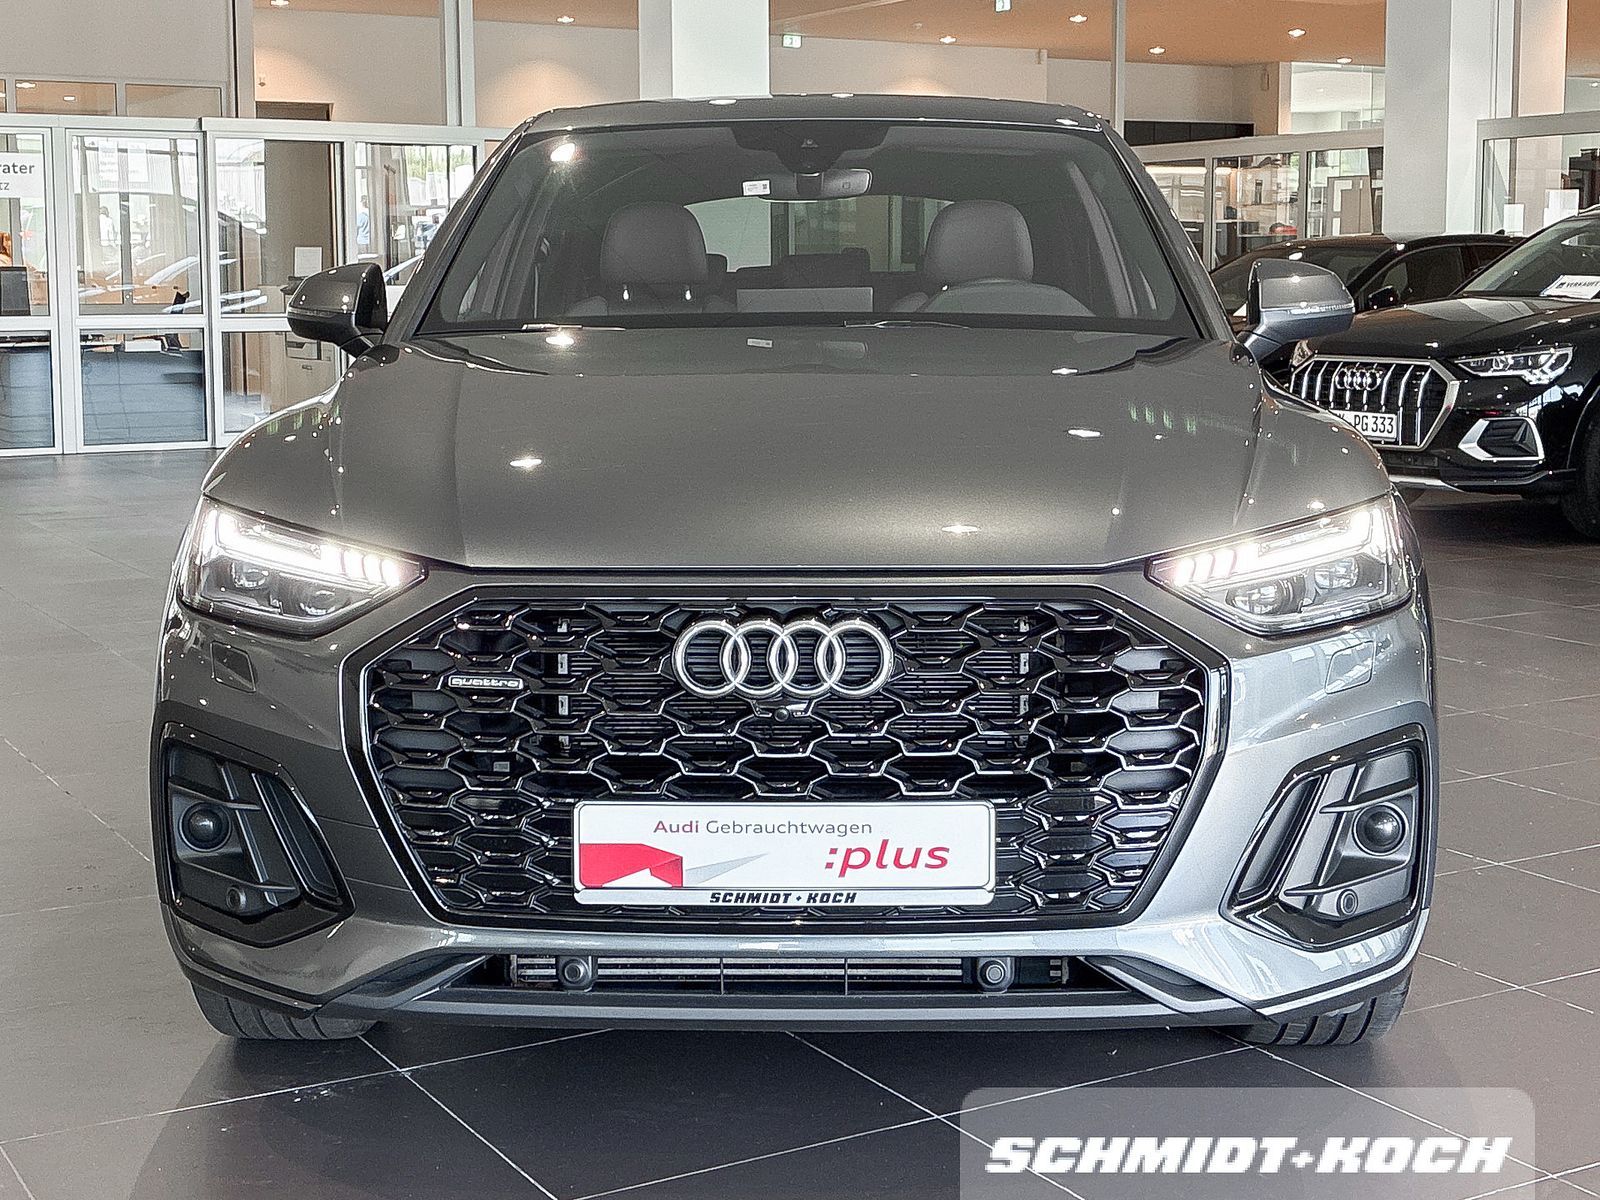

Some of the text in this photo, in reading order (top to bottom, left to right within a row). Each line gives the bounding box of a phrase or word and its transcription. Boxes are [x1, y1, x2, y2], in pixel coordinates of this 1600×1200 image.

[1354, 415, 1369, 431] PG
[1371, 416, 1394, 433] 333
[451, 678, 519, 687] quattro
[653, 820, 873, 837] Audi Gebrauchtwagen
[825, 839, 950, 878] :plus
[709, 892, 792, 904] SCHMIDT
[806, 892, 857, 904] KOCH
